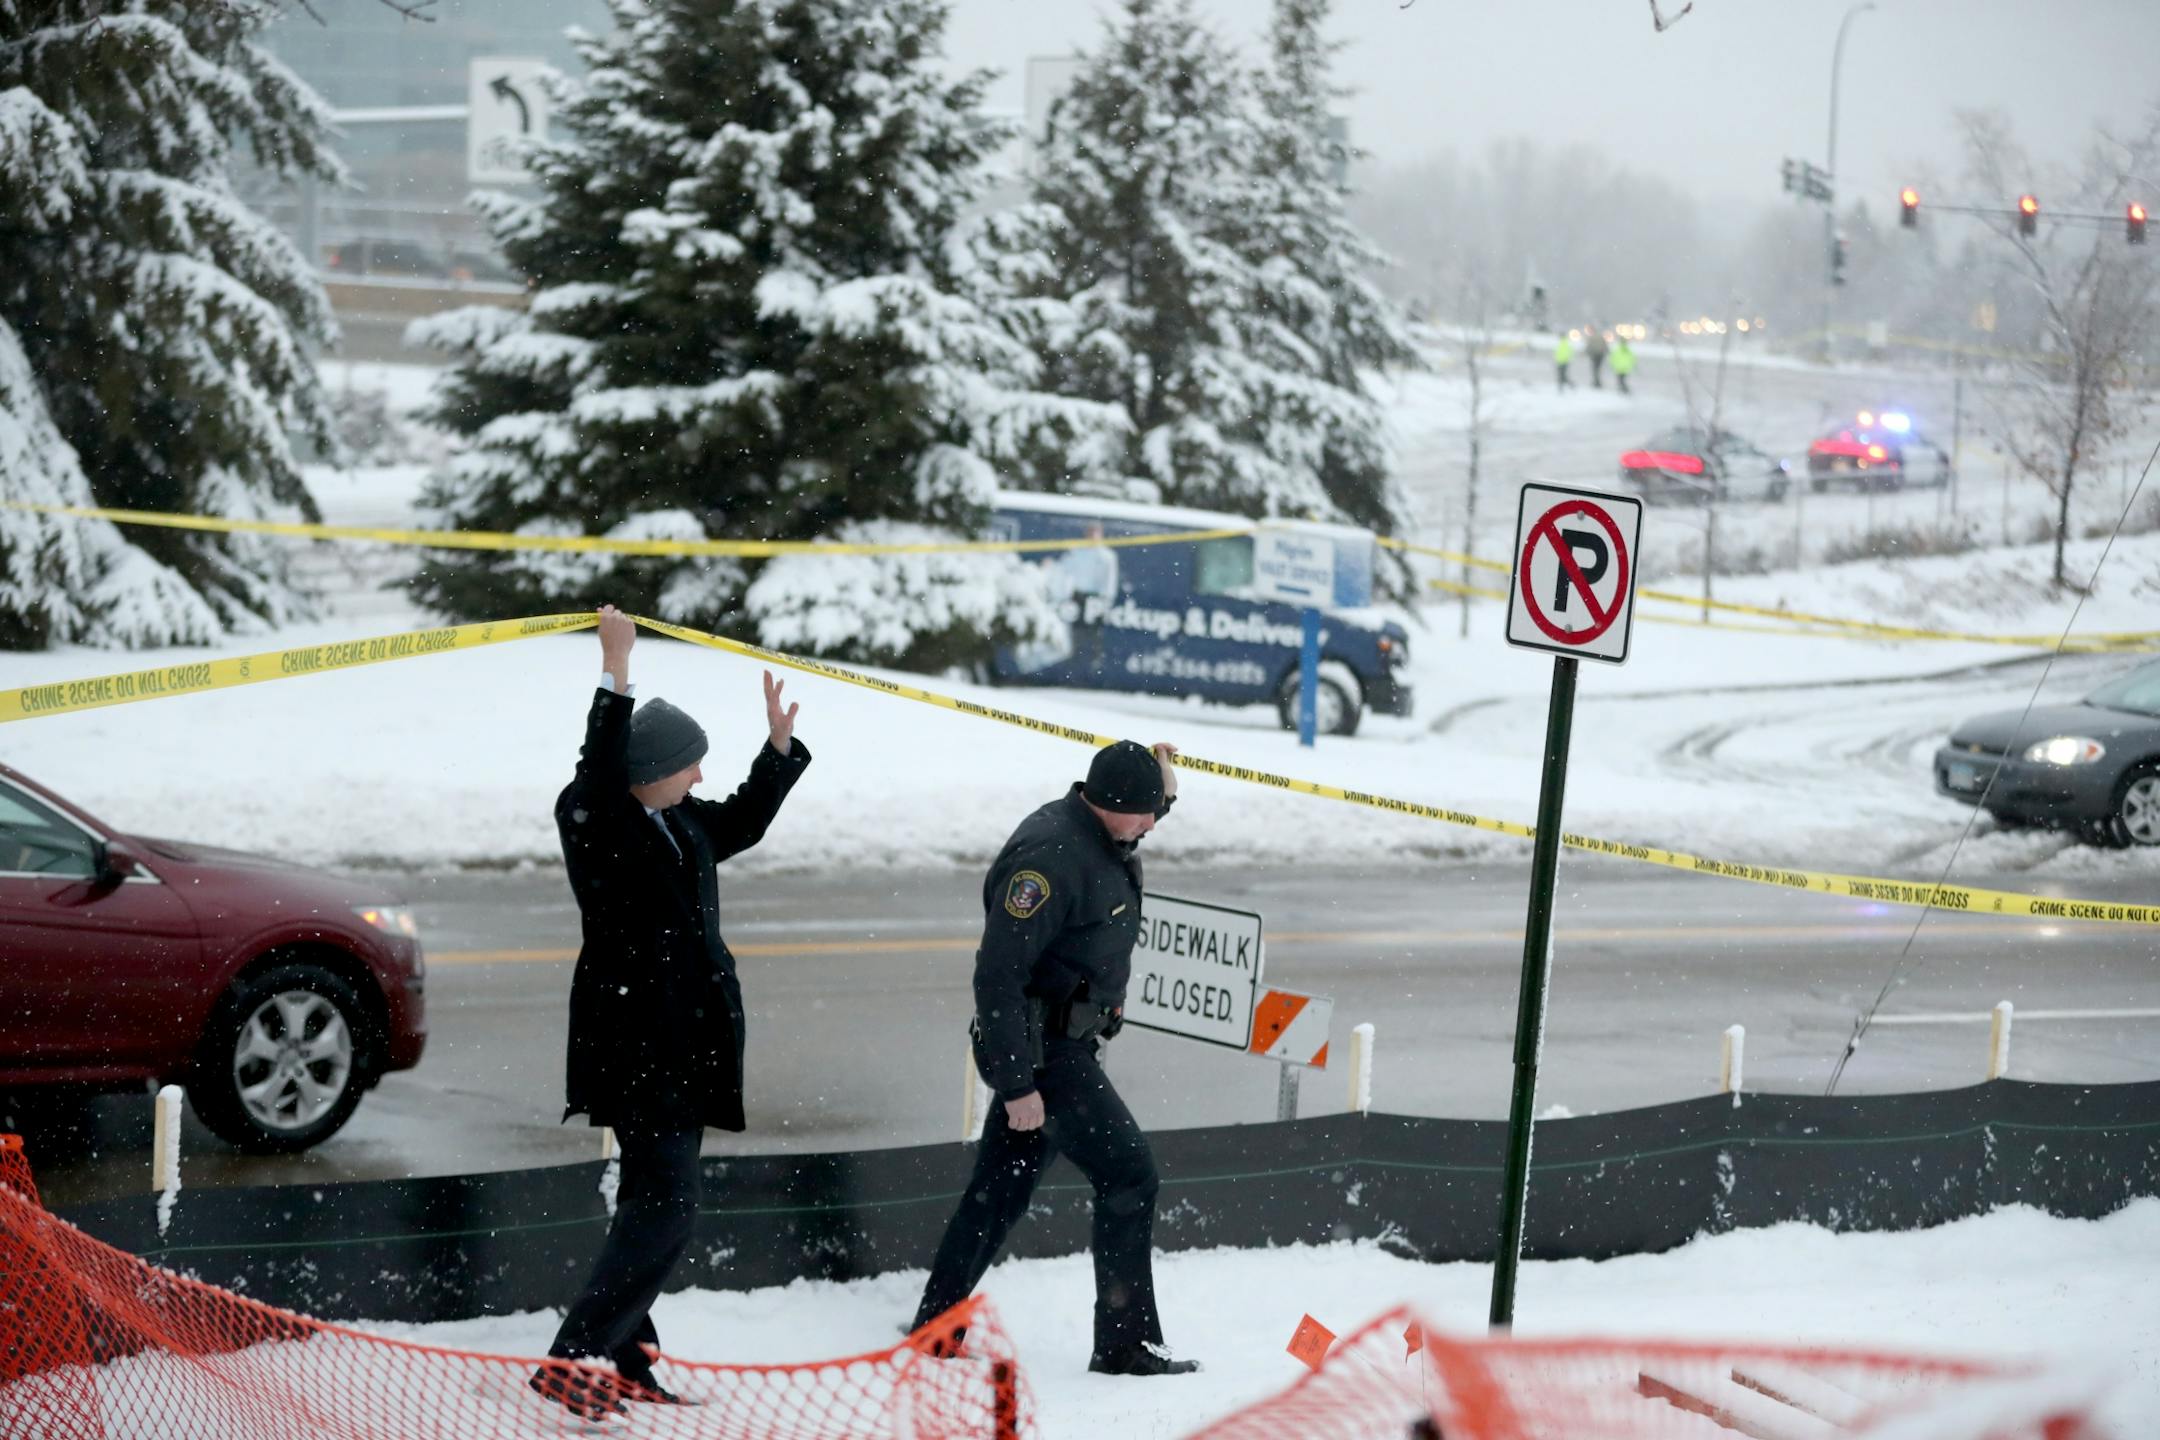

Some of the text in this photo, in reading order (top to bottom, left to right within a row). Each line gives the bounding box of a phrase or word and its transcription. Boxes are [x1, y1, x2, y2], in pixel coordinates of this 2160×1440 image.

[1084, 597, 1180, 640] Pickup
[1184, 606, 1207, 637] &
[1901, 887, 1913, 902] DO
[1915, 887, 1931, 904] NOT
[1932, 889, 1970, 909] CROSS
[2030, 900, 2066, 917] CRIME
[2069, 903, 2105, 919] SCENE
[2108, 906, 2123, 920] DO
[2126, 908, 2148, 921] NOT
[1137, 916, 1251, 970] SIDEWALK
[1143, 972, 1232, 1022] CLOSED
